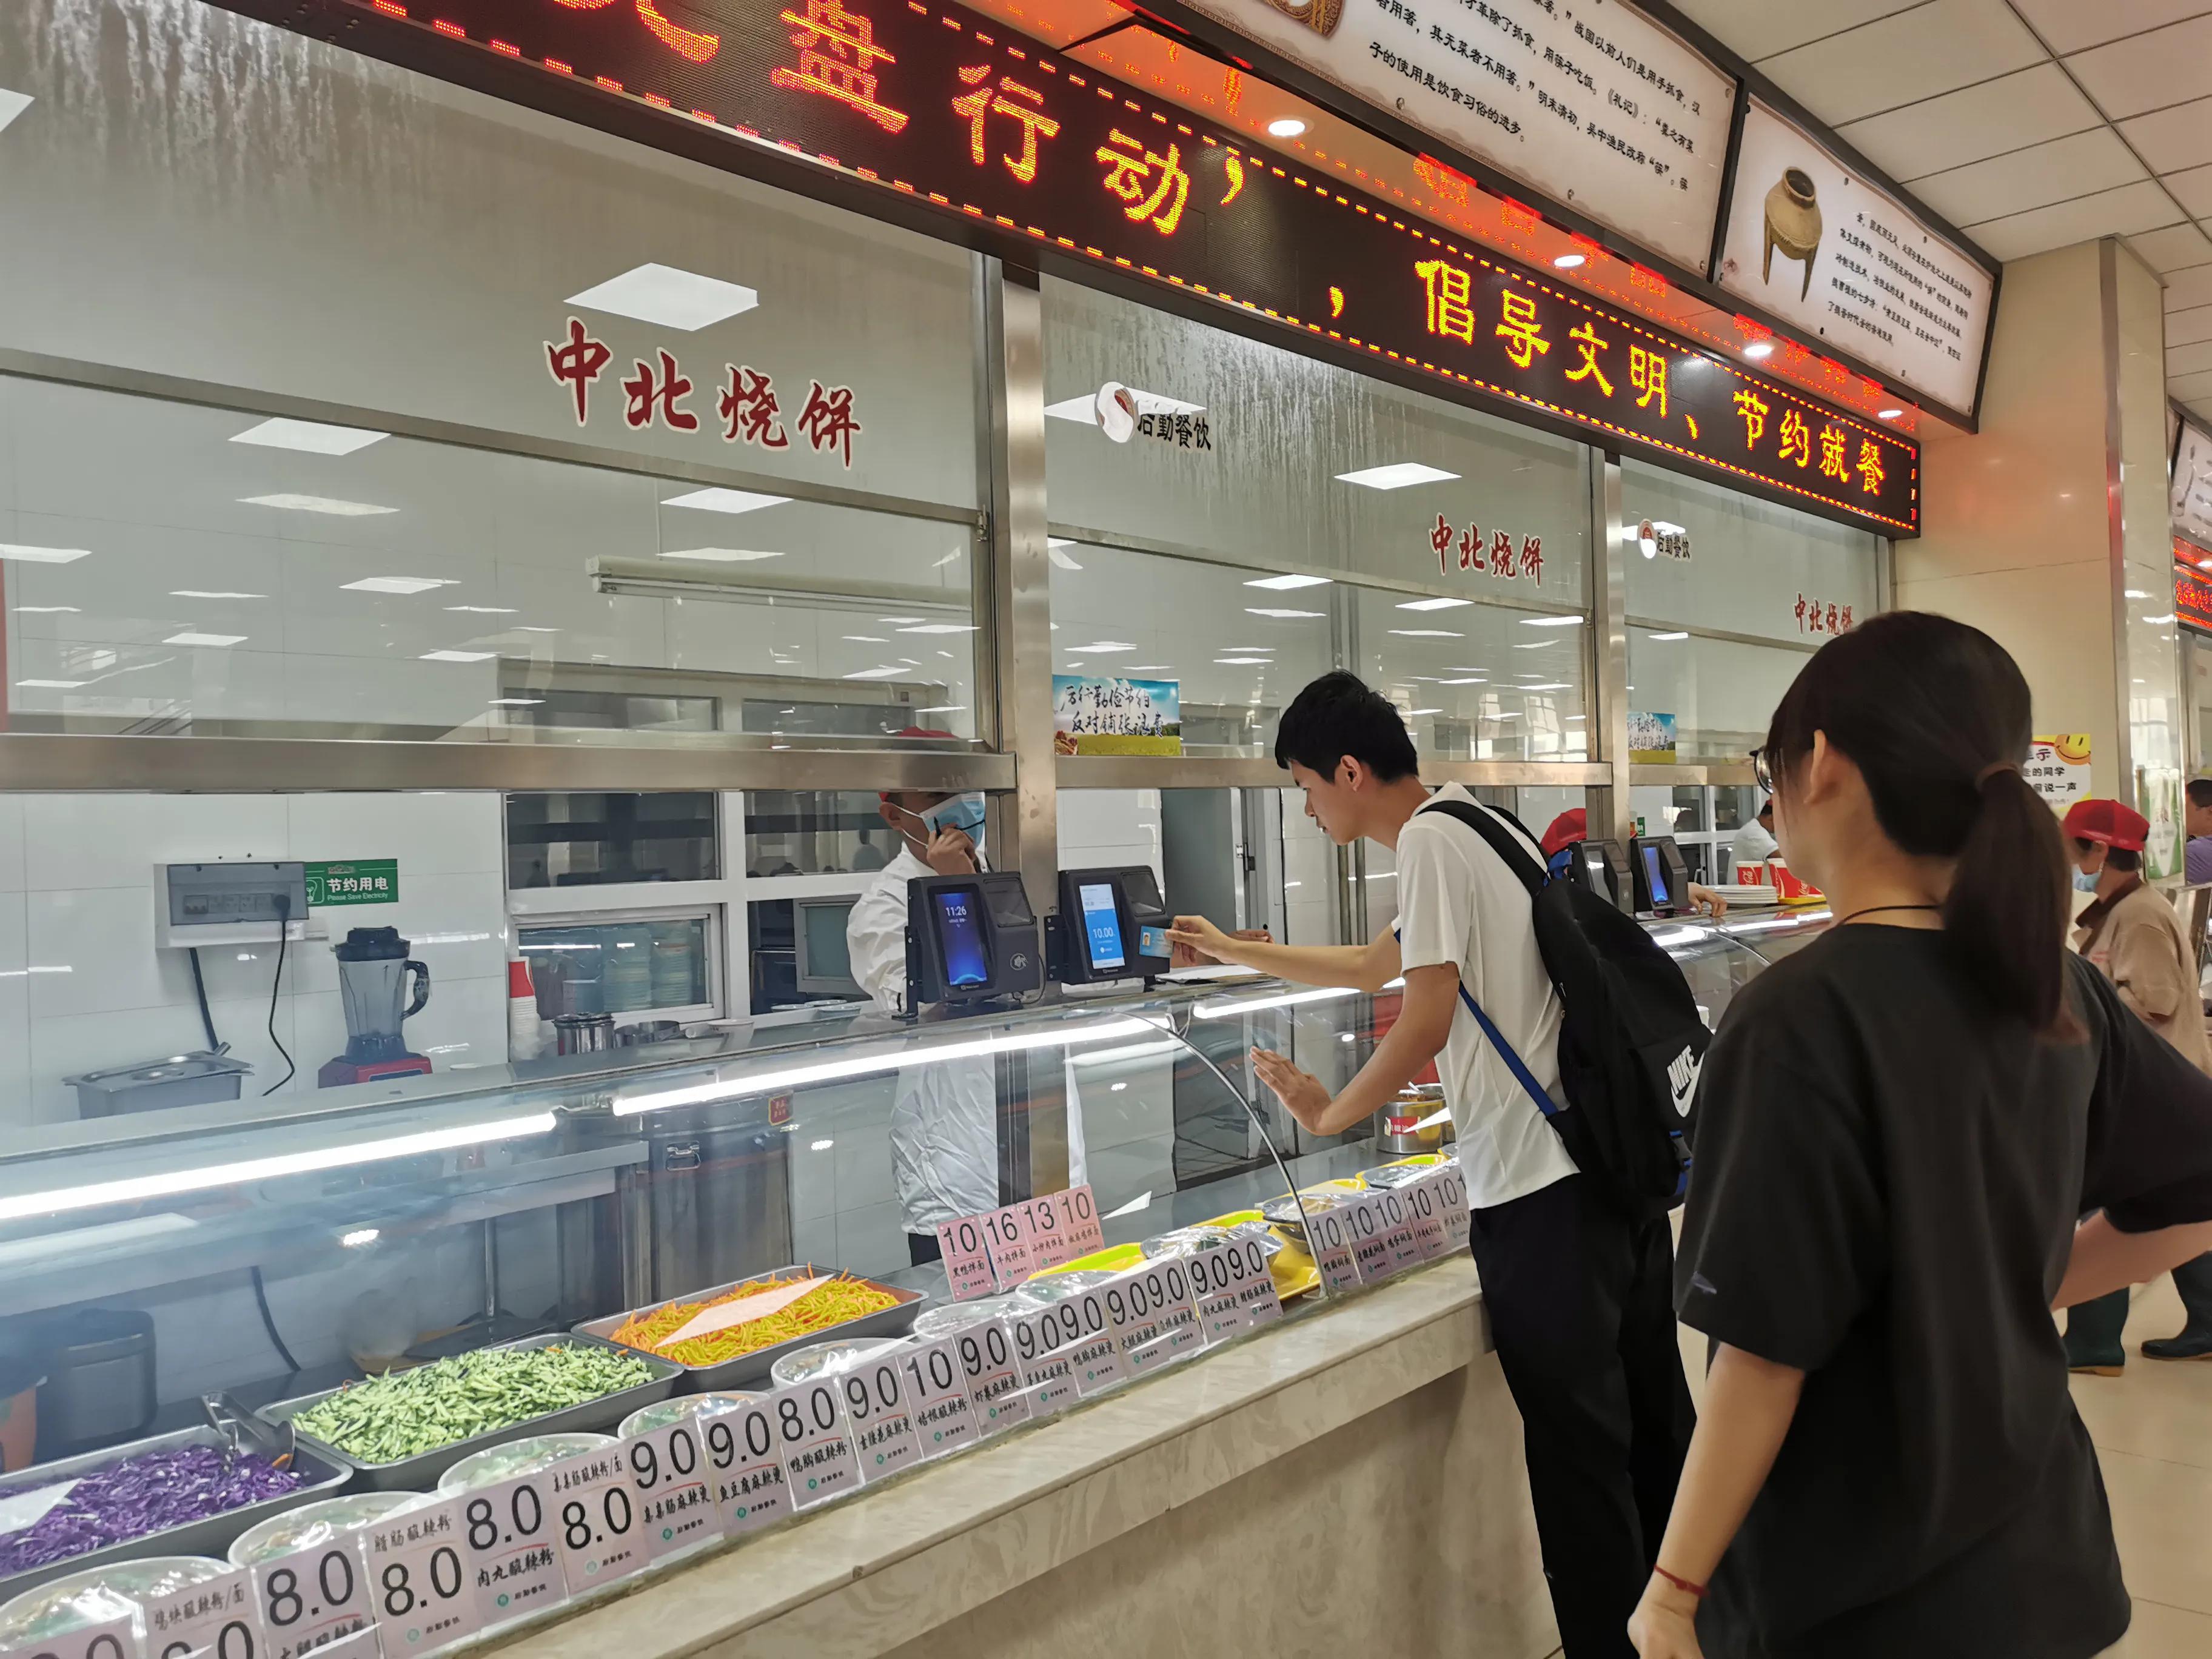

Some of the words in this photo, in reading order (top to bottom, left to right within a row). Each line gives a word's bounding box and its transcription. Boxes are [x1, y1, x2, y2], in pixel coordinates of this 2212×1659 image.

[544, 317, 863, 470] 中北烧饼
[1429, 512, 1544, 588] 中北烧饼
[1794, 592, 1854, 635] 中北烧饼
[326, 877, 389, 893] 节约用电
[945, 906, 967, 917] 11:26
[1667, 1045, 1696, 1096] NIKE
[1062, 1192, 1091, 1224] 10
[1375, 1195, 1402, 1228] 10
[1408, 1188, 1432, 1219] 10
[1434, 1178, 1458, 1208] 10
[943, 1223, 977, 1256] 10
[987, 1213, 1018, 1245] 16
[1025, 1202, 1054, 1233] 13
[1314, 1216, 1341, 1251] 10
[1346, 1206, 1374, 1239] 10
[1191, 1255, 1228, 1294] 9.0
[1228, 1241, 1263, 1280] 9.0
[1107, 1282, 1148, 1326] 9.0
[1146, 1267, 1184, 1308] 9.0
[1016, 1314, 1060, 1360] 9.0
[1061, 1296, 1102, 1340] 9.0
[907, 1351, 953, 1396] 10
[961, 1328, 1007, 1376] 9.0
[779, 1387, 834, 1441] 8.0
[846, 1366, 898, 1419] 9.0
[631, 1429, 695, 1489] 9.0
[708, 1411, 770, 1469] 9.0
[466, 1484, 541, 1550] 8.0
[563, 1487, 631, 1550] 8.0
[267, 1550, 354, 1626] 8.0
[382, 1547, 462, 1617] 8.0
